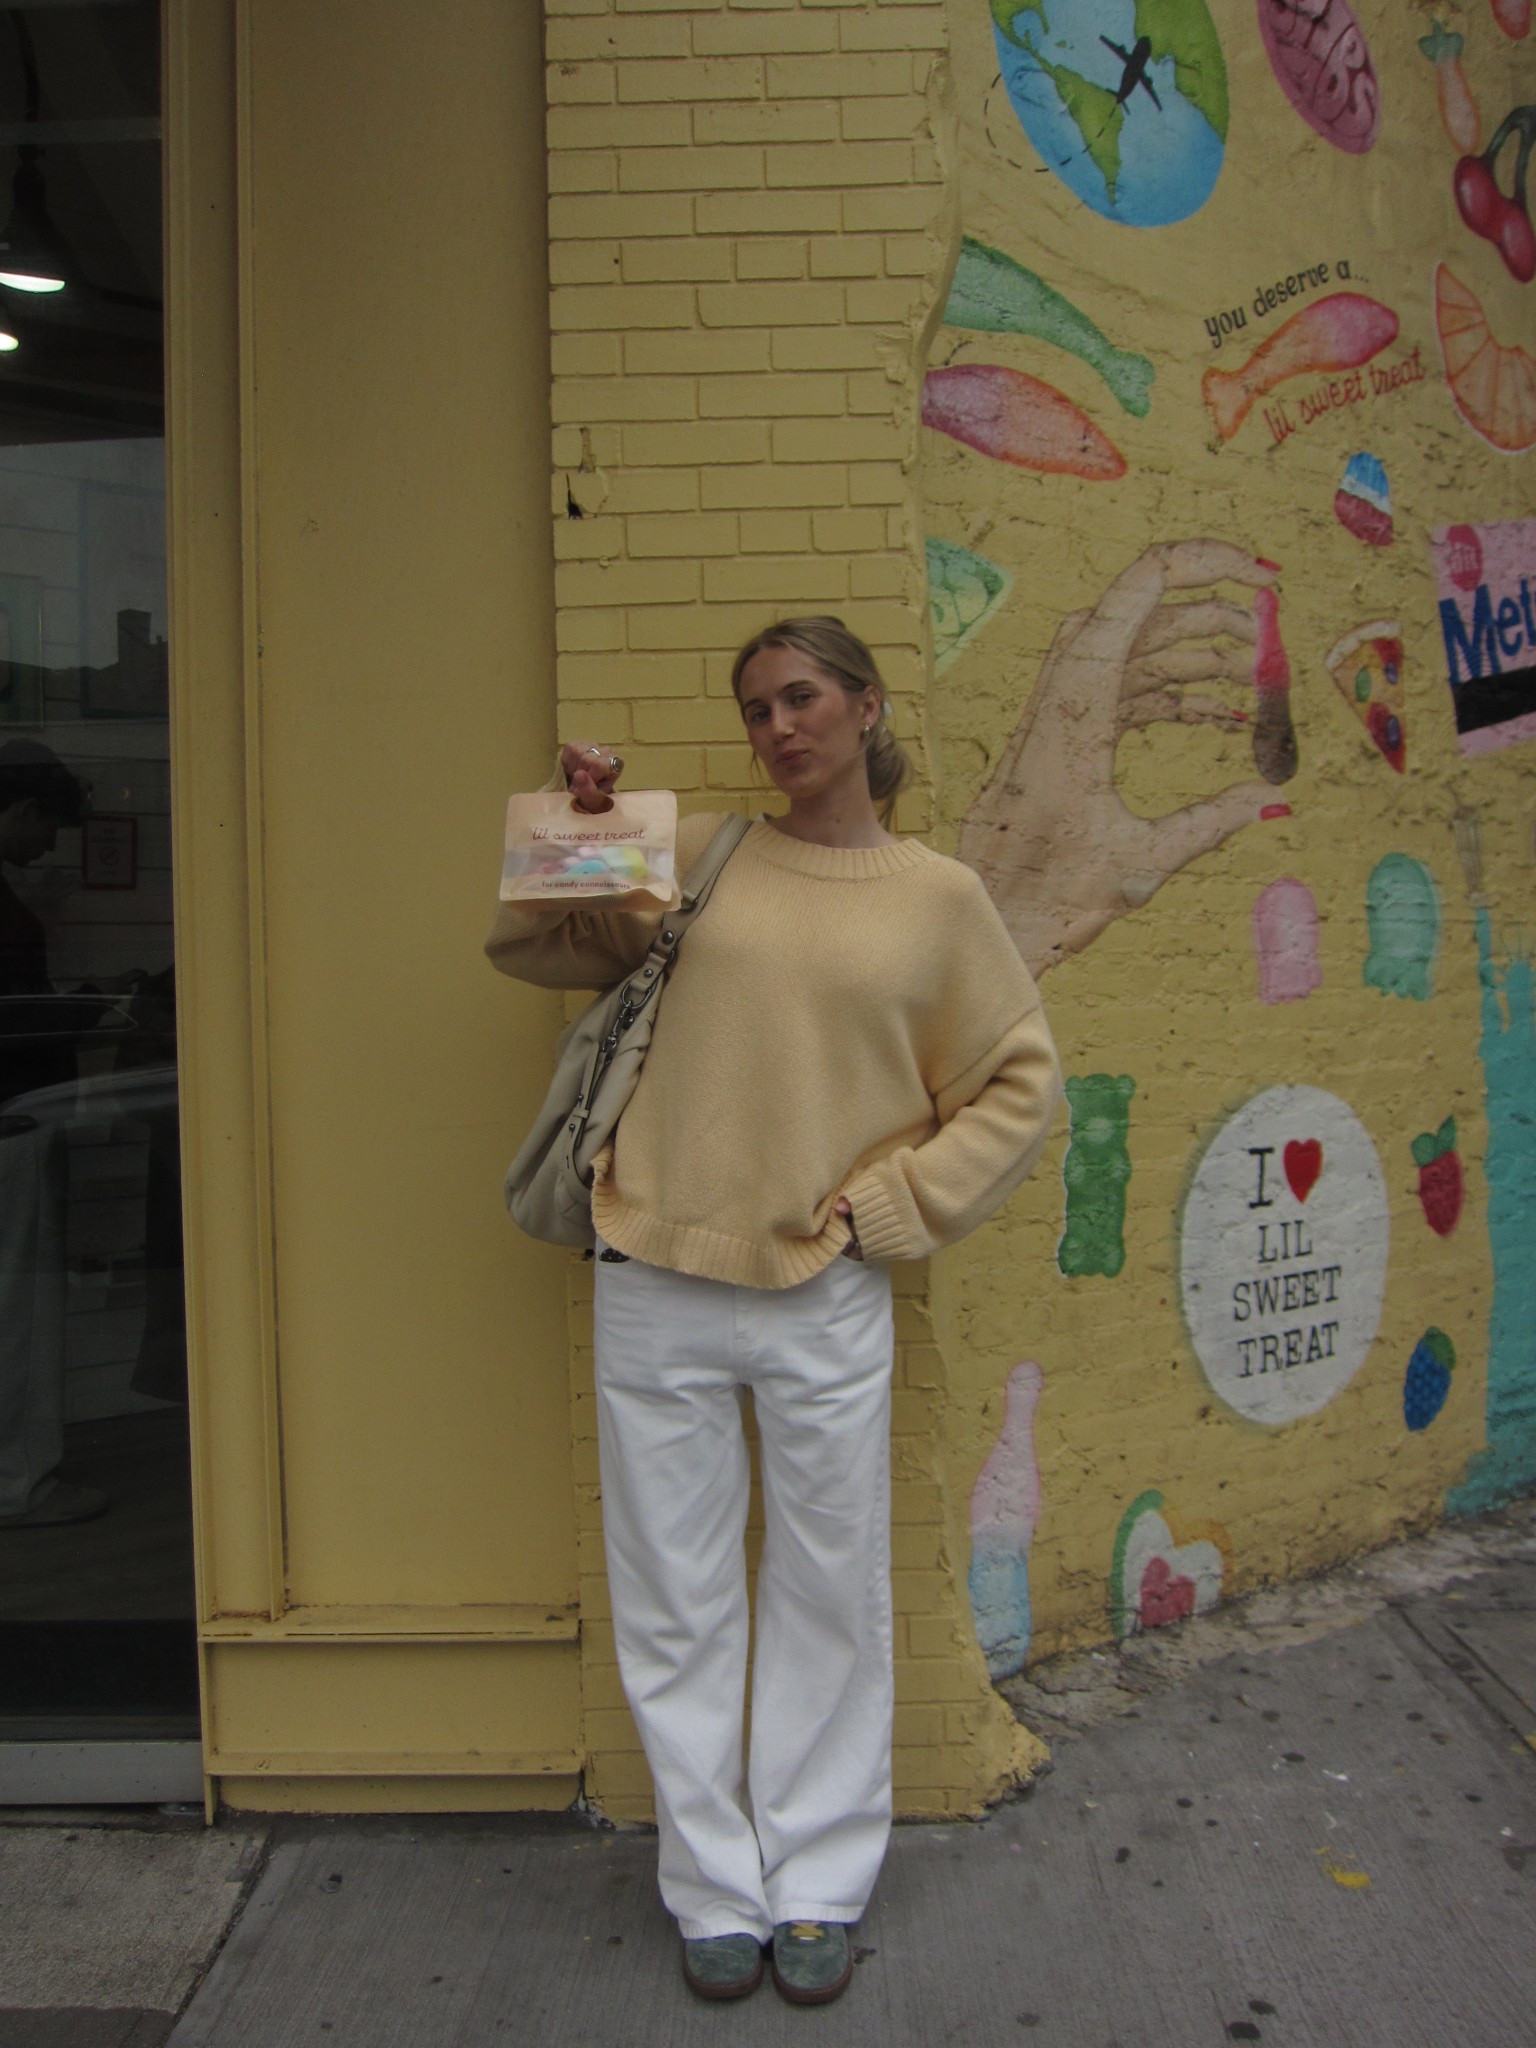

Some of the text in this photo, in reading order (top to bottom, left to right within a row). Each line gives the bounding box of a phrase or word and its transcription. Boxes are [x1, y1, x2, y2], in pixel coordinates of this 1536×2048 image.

[1204, 306, 1248, 348] you
[1254, 259, 1330, 317] deserve
[1263, 346, 1426, 444] lil sweet treat
[1439, 577, 1536, 685] Met
[532, 827, 647, 841] lil sweet treat
[555, 881, 578, 889] candy
[1248, 1146, 1275, 1210] I
[1258, 1219, 1312, 1263] LIL
[1233, 1265, 1341, 1322] SWEET
[1238, 1321, 1339, 1379] TREAT
